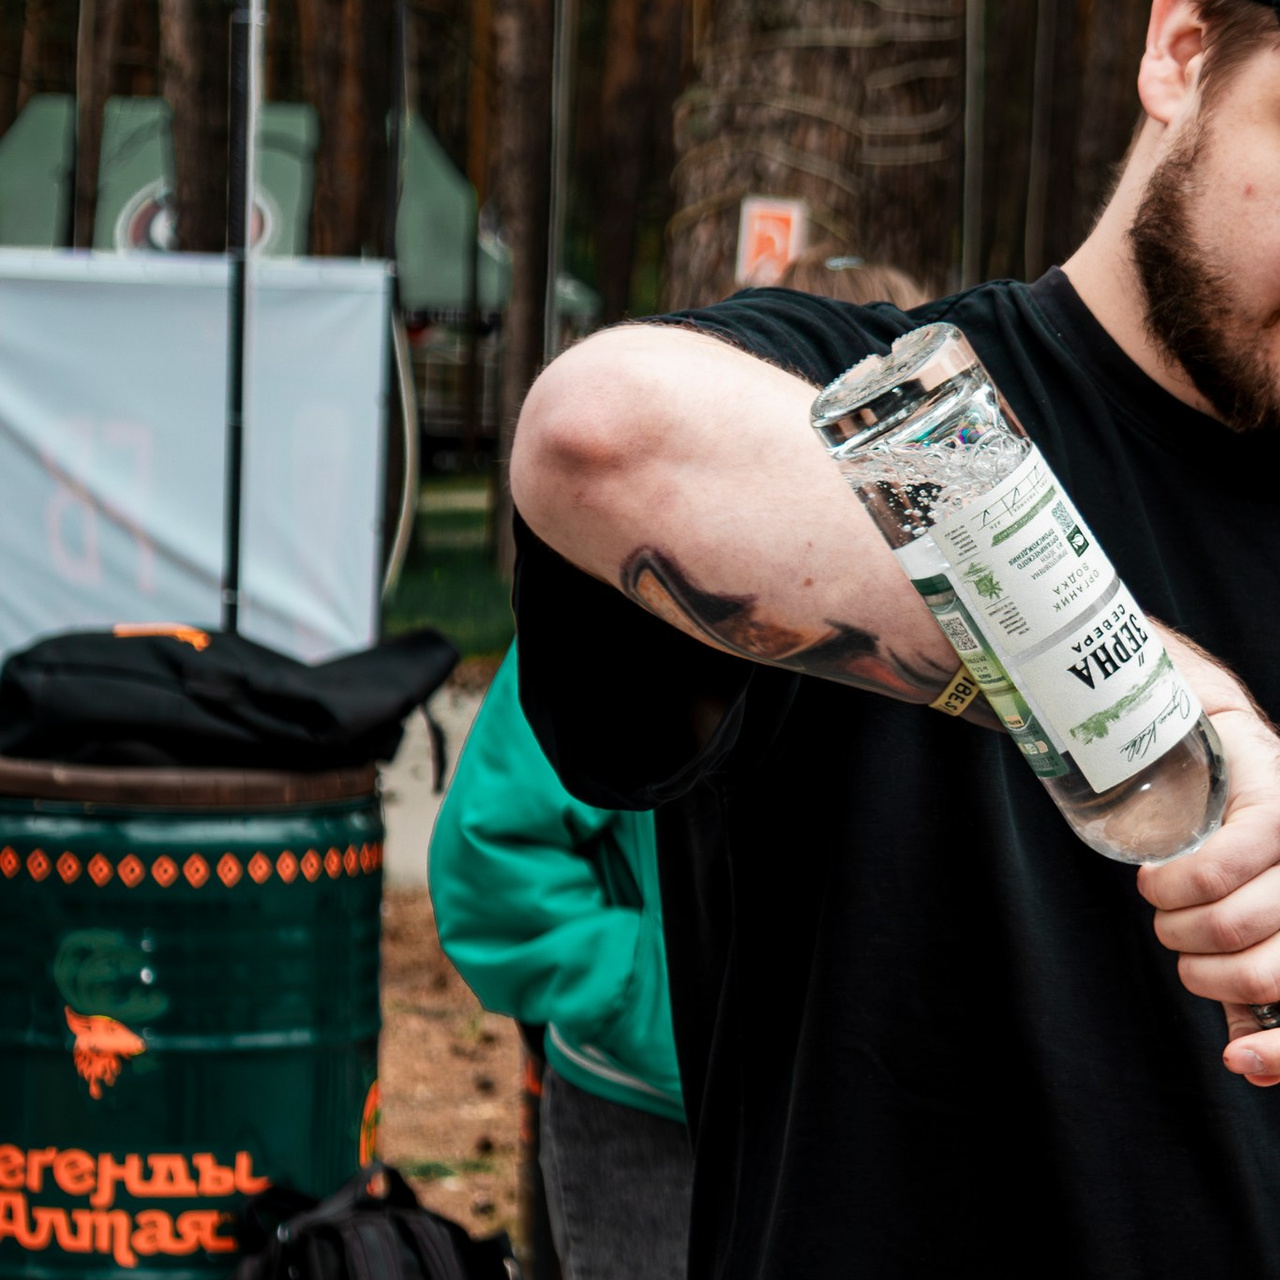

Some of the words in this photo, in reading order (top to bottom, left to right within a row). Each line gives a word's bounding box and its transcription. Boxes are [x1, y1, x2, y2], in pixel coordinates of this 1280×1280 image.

[1051, 561, 1089, 595] ВОДКА
[1051, 568, 1099, 612] ОРГАНИК
[1065, 612, 1148, 689] ЗЁРНА
[1070, 603, 1126, 653] СЕВЕРА
